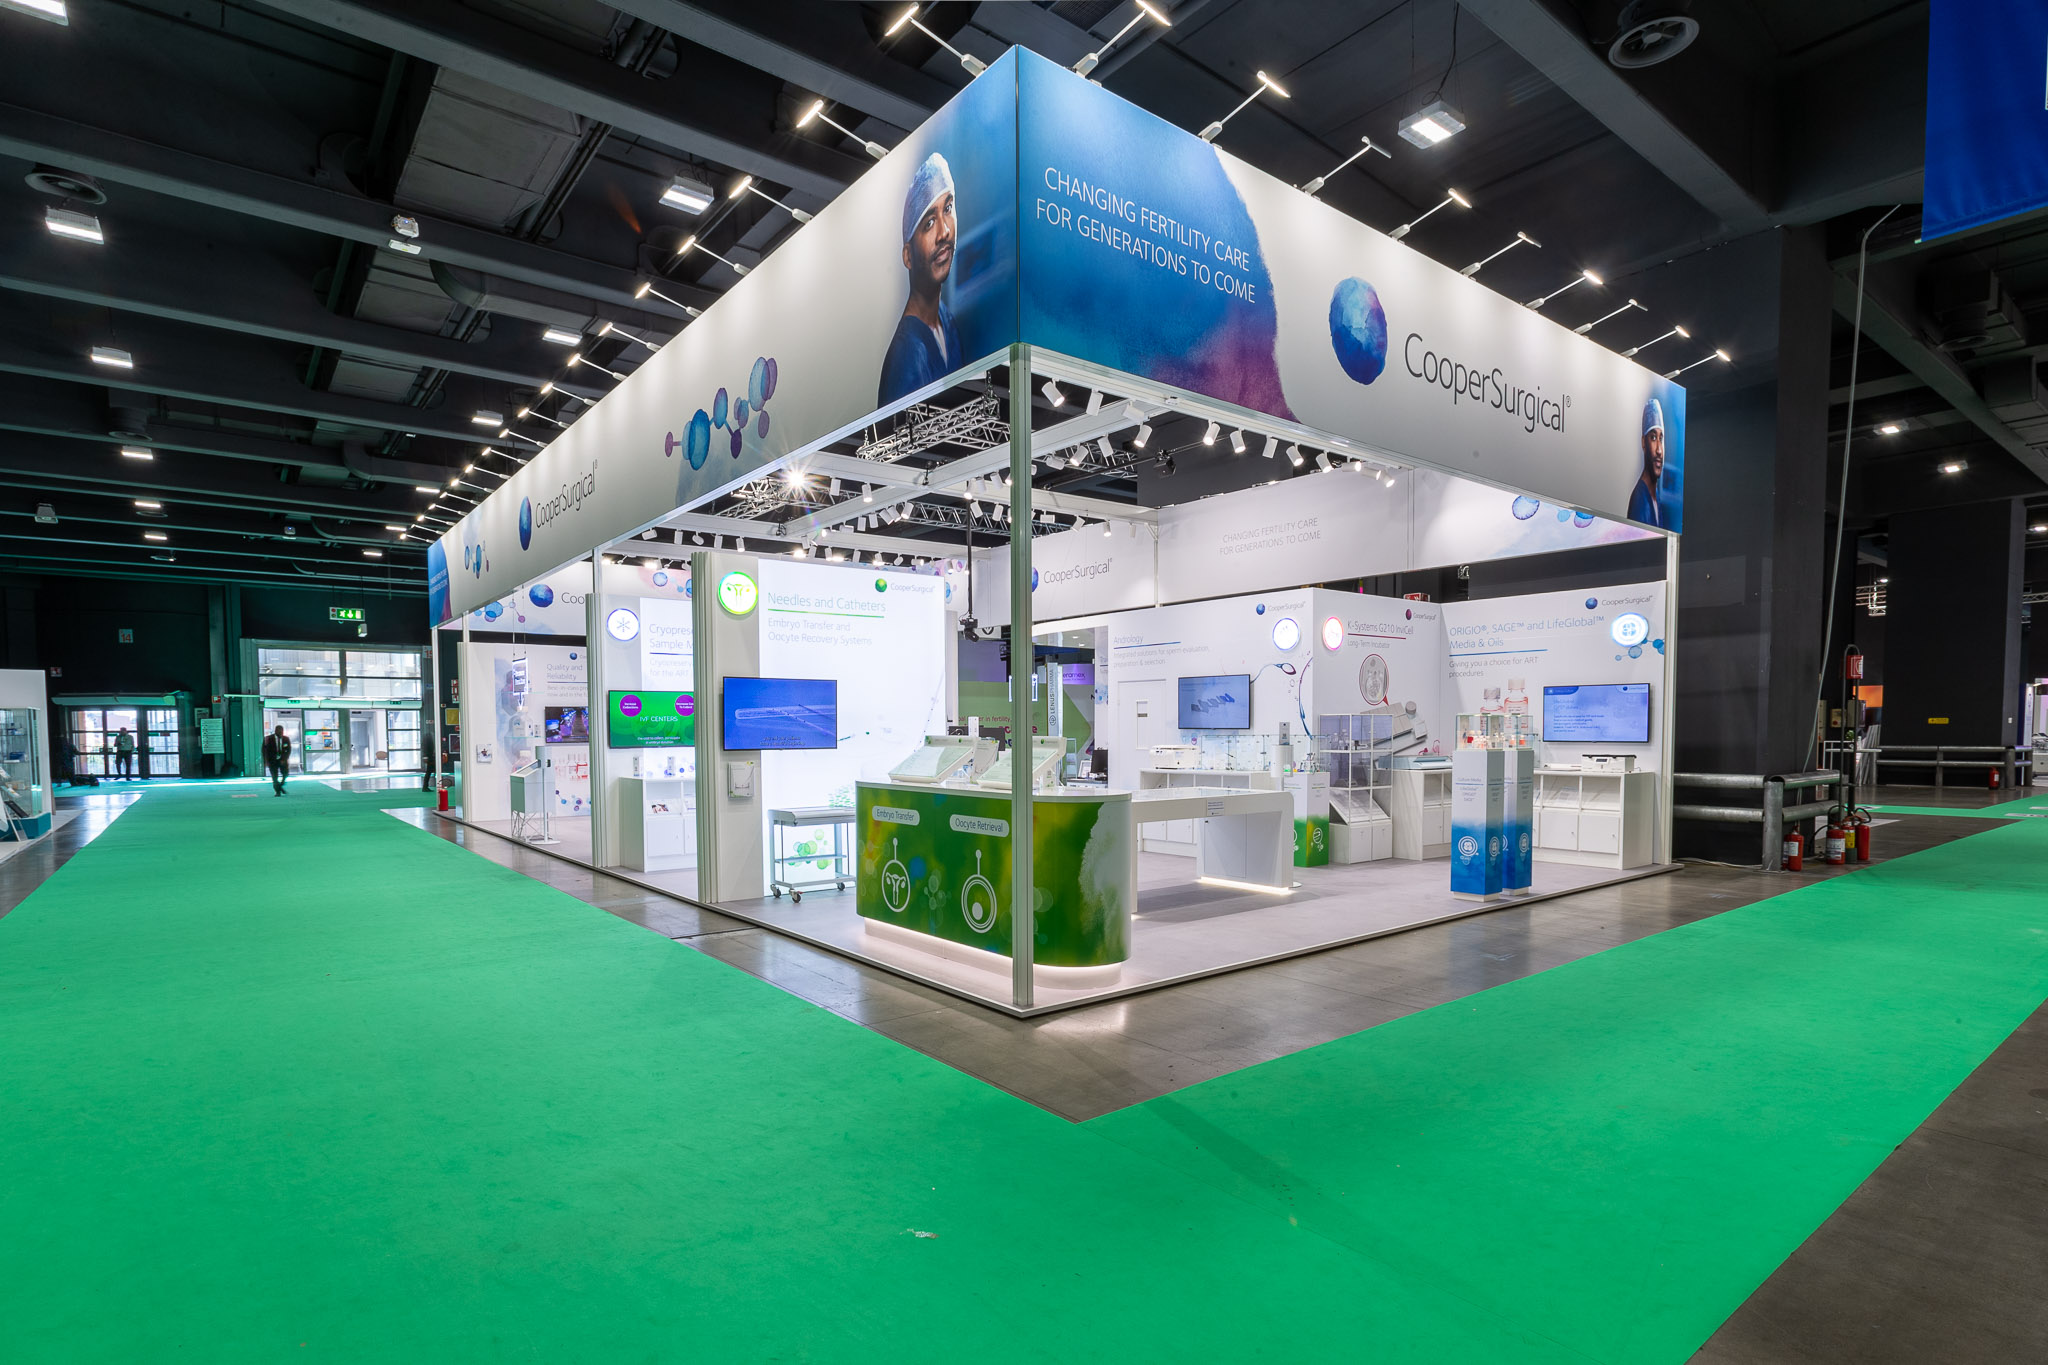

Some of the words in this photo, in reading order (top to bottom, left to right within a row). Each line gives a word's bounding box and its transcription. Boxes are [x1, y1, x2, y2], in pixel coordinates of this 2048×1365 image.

[1044, 167, 1136, 223] CHANGING
[1141, 206, 1211, 254] FERTILITY
[1214, 240, 1250, 272] CARE
[1036, 198, 1072, 231] FOR
[1077, 214, 1187, 276] GENERATIONS
[1191, 259, 1211, 285] TO
[1214, 271, 1256, 304] COME
[1222, 529, 1260, 543] CHANGING
[1261, 522, 1296, 536] FERTILITY
[1297, 517, 1318, 530] CARE
[1219, 546, 1234, 555] FOR
[1235, 539, 1283, 554] GENERATIONS
[1286, 535, 1296, 544] TO
[1297, 530, 1321, 543] COME
[767, 592, 811, 608] Needles
[814, 597, 834, 609] and
[836, 597, 887, 612] Catheters
[767, 617, 800, 630] Embryo
[803, 619, 834, 631] Transfer
[835, 622, 851, 632] and
[1347, 621, 1378, 633] K-Systems
[1378, 623, 1394, 633] G210
[1527, 621, 1544, 630] and
[649, 638, 684, 651] Sample
[767, 632, 800, 643] Oocyte
[801, 633, 839, 646] Recovery
[840, 635, 872, 647] Systems
[1113, 634, 1144, 645] Andrology
[1449, 638, 1476, 649] Media
[1478, 638, 1486, 648] &
[1487, 637, 1504, 648] Oils
[571, 663, 583, 671] and
[1448, 660, 1469, 669] Giving
[1470, 661, 1483, 669] you
[1489, 658, 1510, 666] choice
[1512, 657, 1523, 665] for
[1523, 656, 1539, 664] ART
[546, 672, 577, 680] Reliability
[1448, 669, 1484, 678] procedures
[876, 808, 895, 820] Embryo
[895, 810, 915, 821] Transfer
[955, 817, 976, 830] Oocyte
[977, 820, 1004, 833] Retrieval
